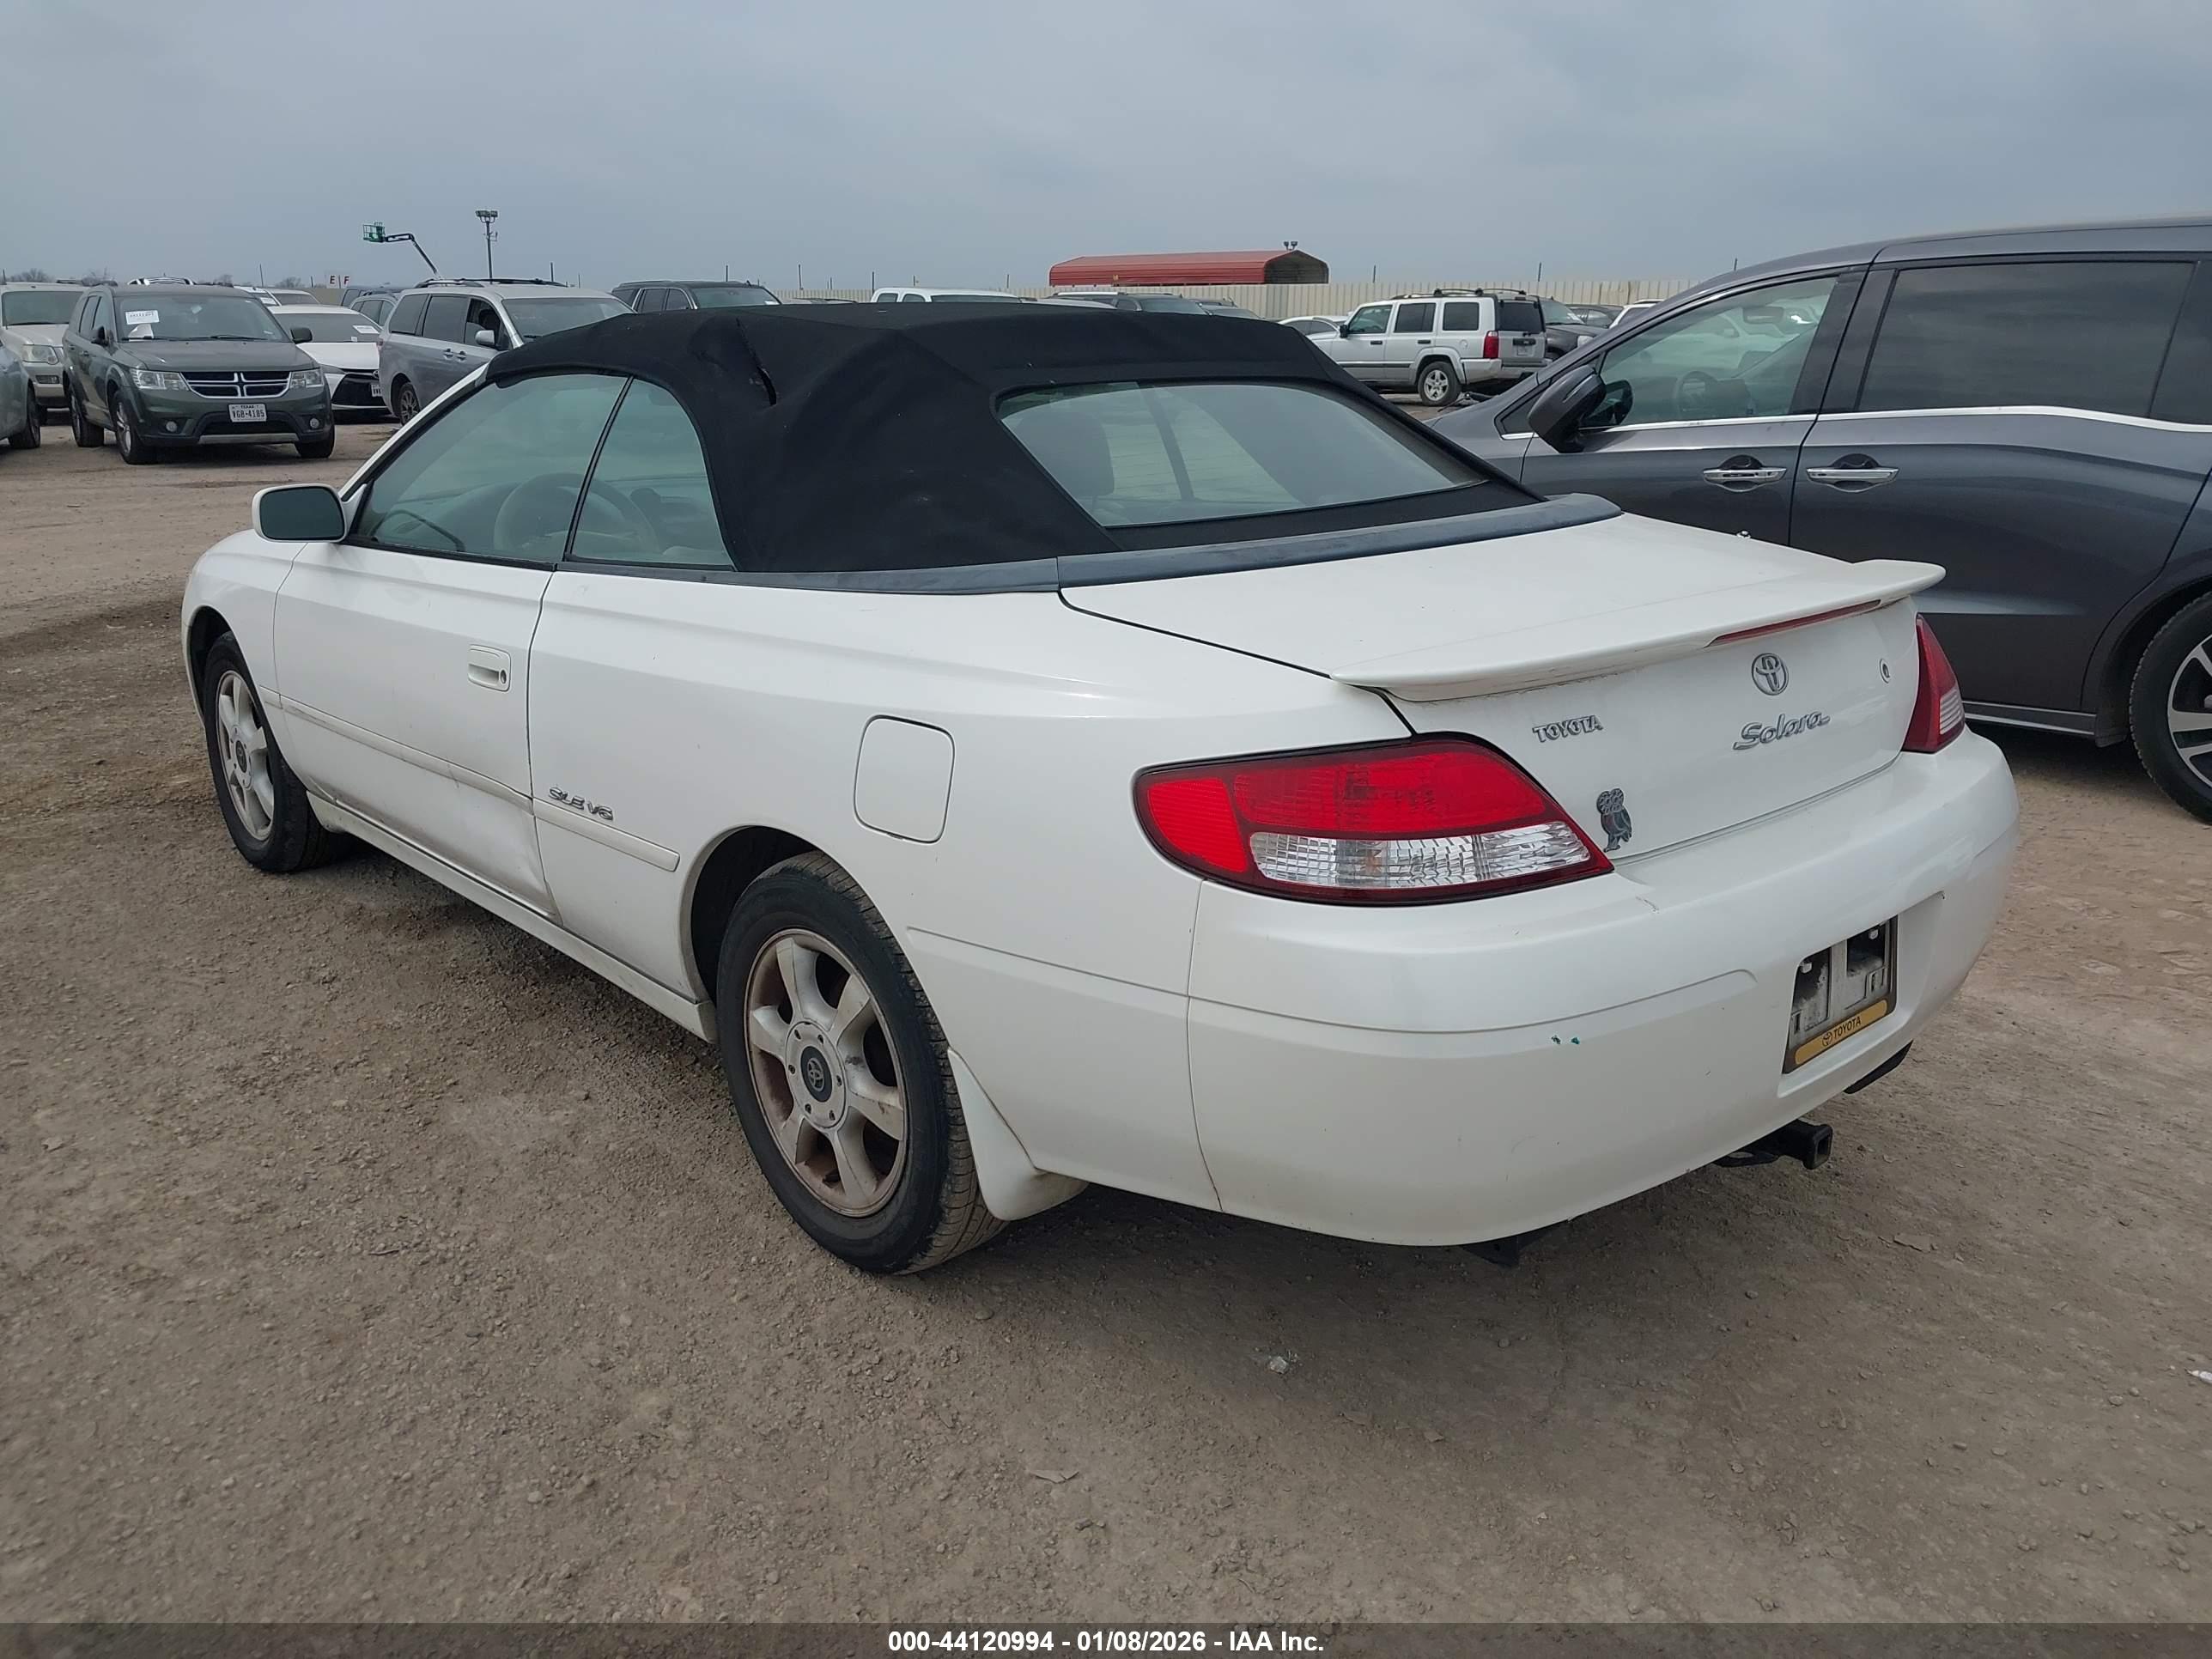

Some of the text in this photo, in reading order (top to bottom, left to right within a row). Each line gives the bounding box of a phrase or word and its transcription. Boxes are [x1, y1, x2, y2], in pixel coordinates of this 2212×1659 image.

[330, 275, 336, 284] E
[343, 276, 349, 284] F
[1532, 714, 1603, 743] TOYOTA
[1733, 712, 1831, 750] Solara
[549, 787, 614, 821] SLE V6
[1833, 1016, 1862, 1039] TOYOTA
